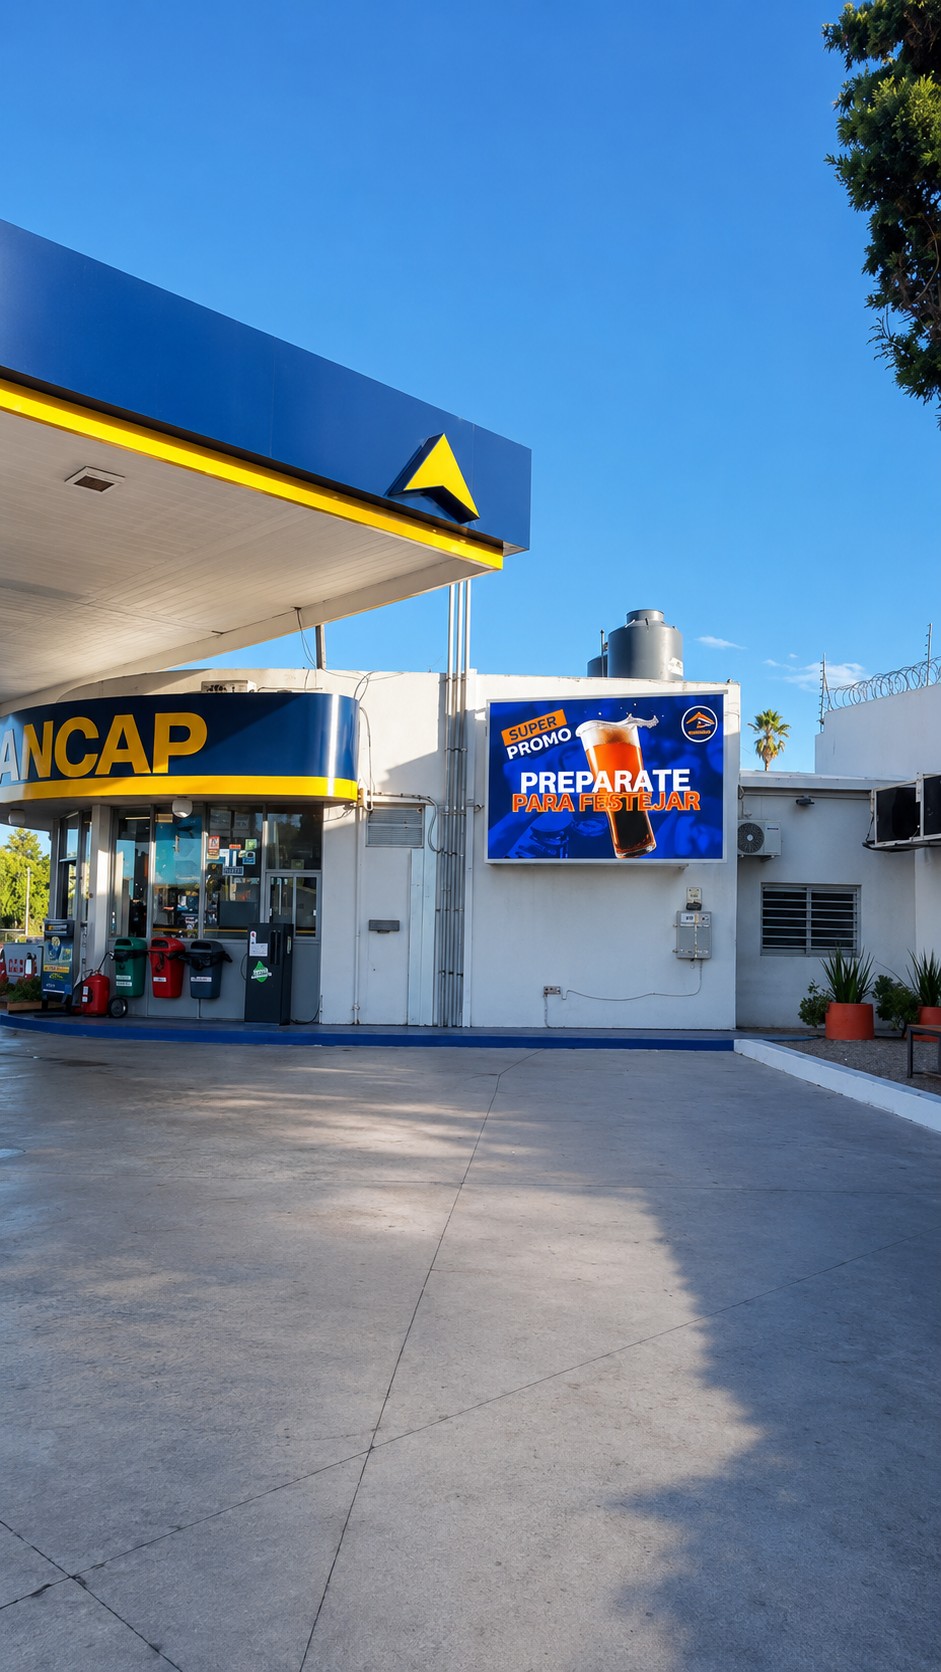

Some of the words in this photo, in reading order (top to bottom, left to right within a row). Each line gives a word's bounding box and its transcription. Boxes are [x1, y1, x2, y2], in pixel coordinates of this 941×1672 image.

[508, 716, 557, 741] SUPER
[0, 712, 208, 783] ANCAP
[506, 728, 571, 759] PROMO
[520, 769, 690, 793] PREPARATE
[512, 793, 575, 812] PARA
[579, 791, 701, 812] FESTEJAR
